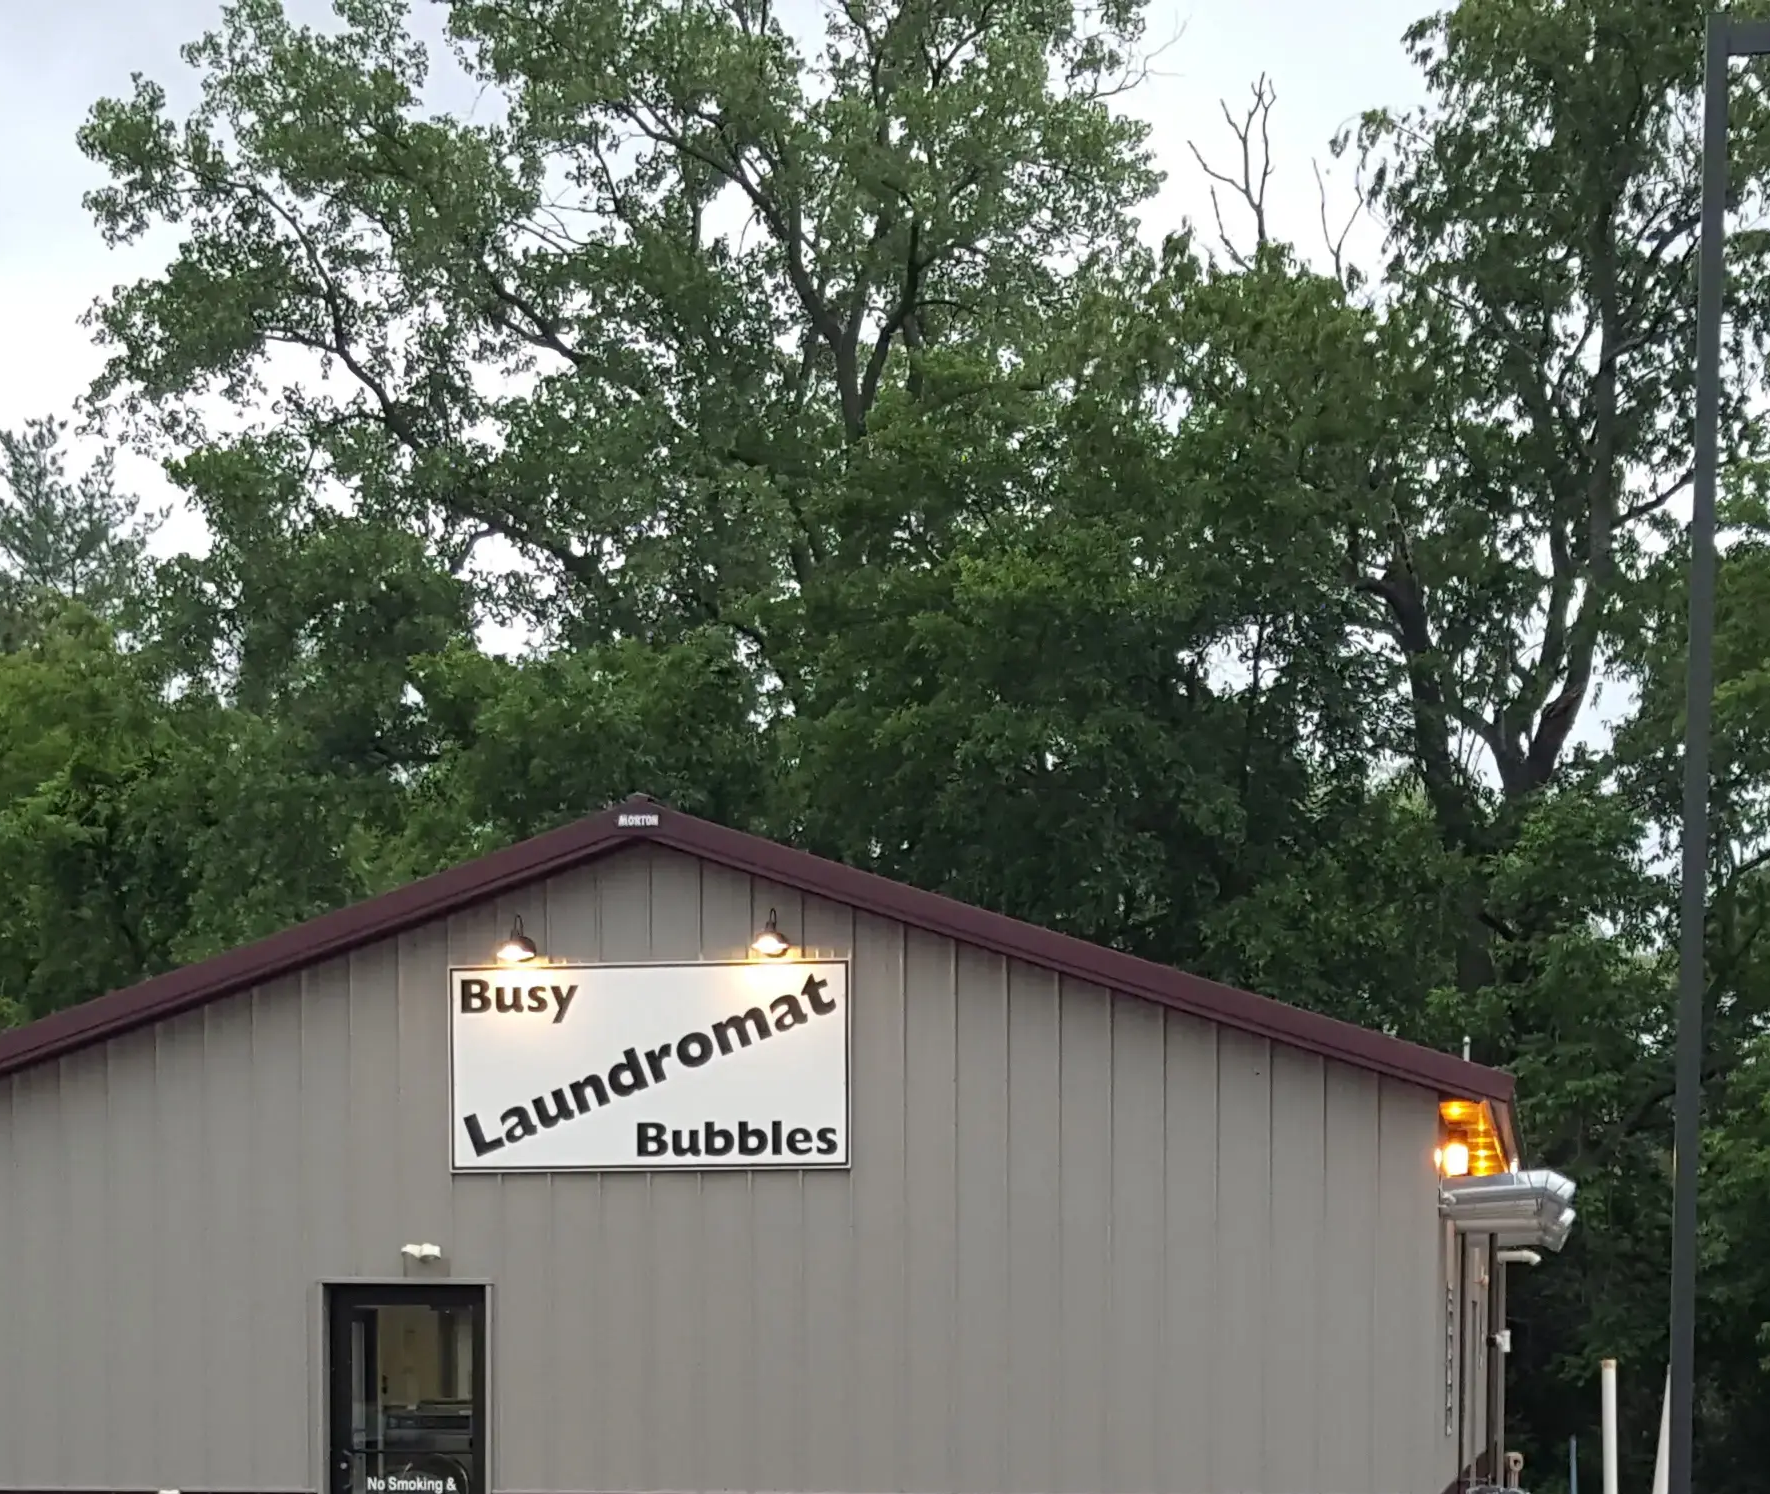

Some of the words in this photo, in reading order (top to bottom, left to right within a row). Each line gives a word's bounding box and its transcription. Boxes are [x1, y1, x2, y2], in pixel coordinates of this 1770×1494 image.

[617, 814, 659, 827] MORTON
[461, 979, 578, 1024] Busy
[463, 973, 836, 1157] Laundromat
[636, 1121, 838, 1157] Bubbles
[367, 1476, 386, 1491] No
[388, 1476, 443, 1494] Smoking
[446, 1477, 456, 1491] &
